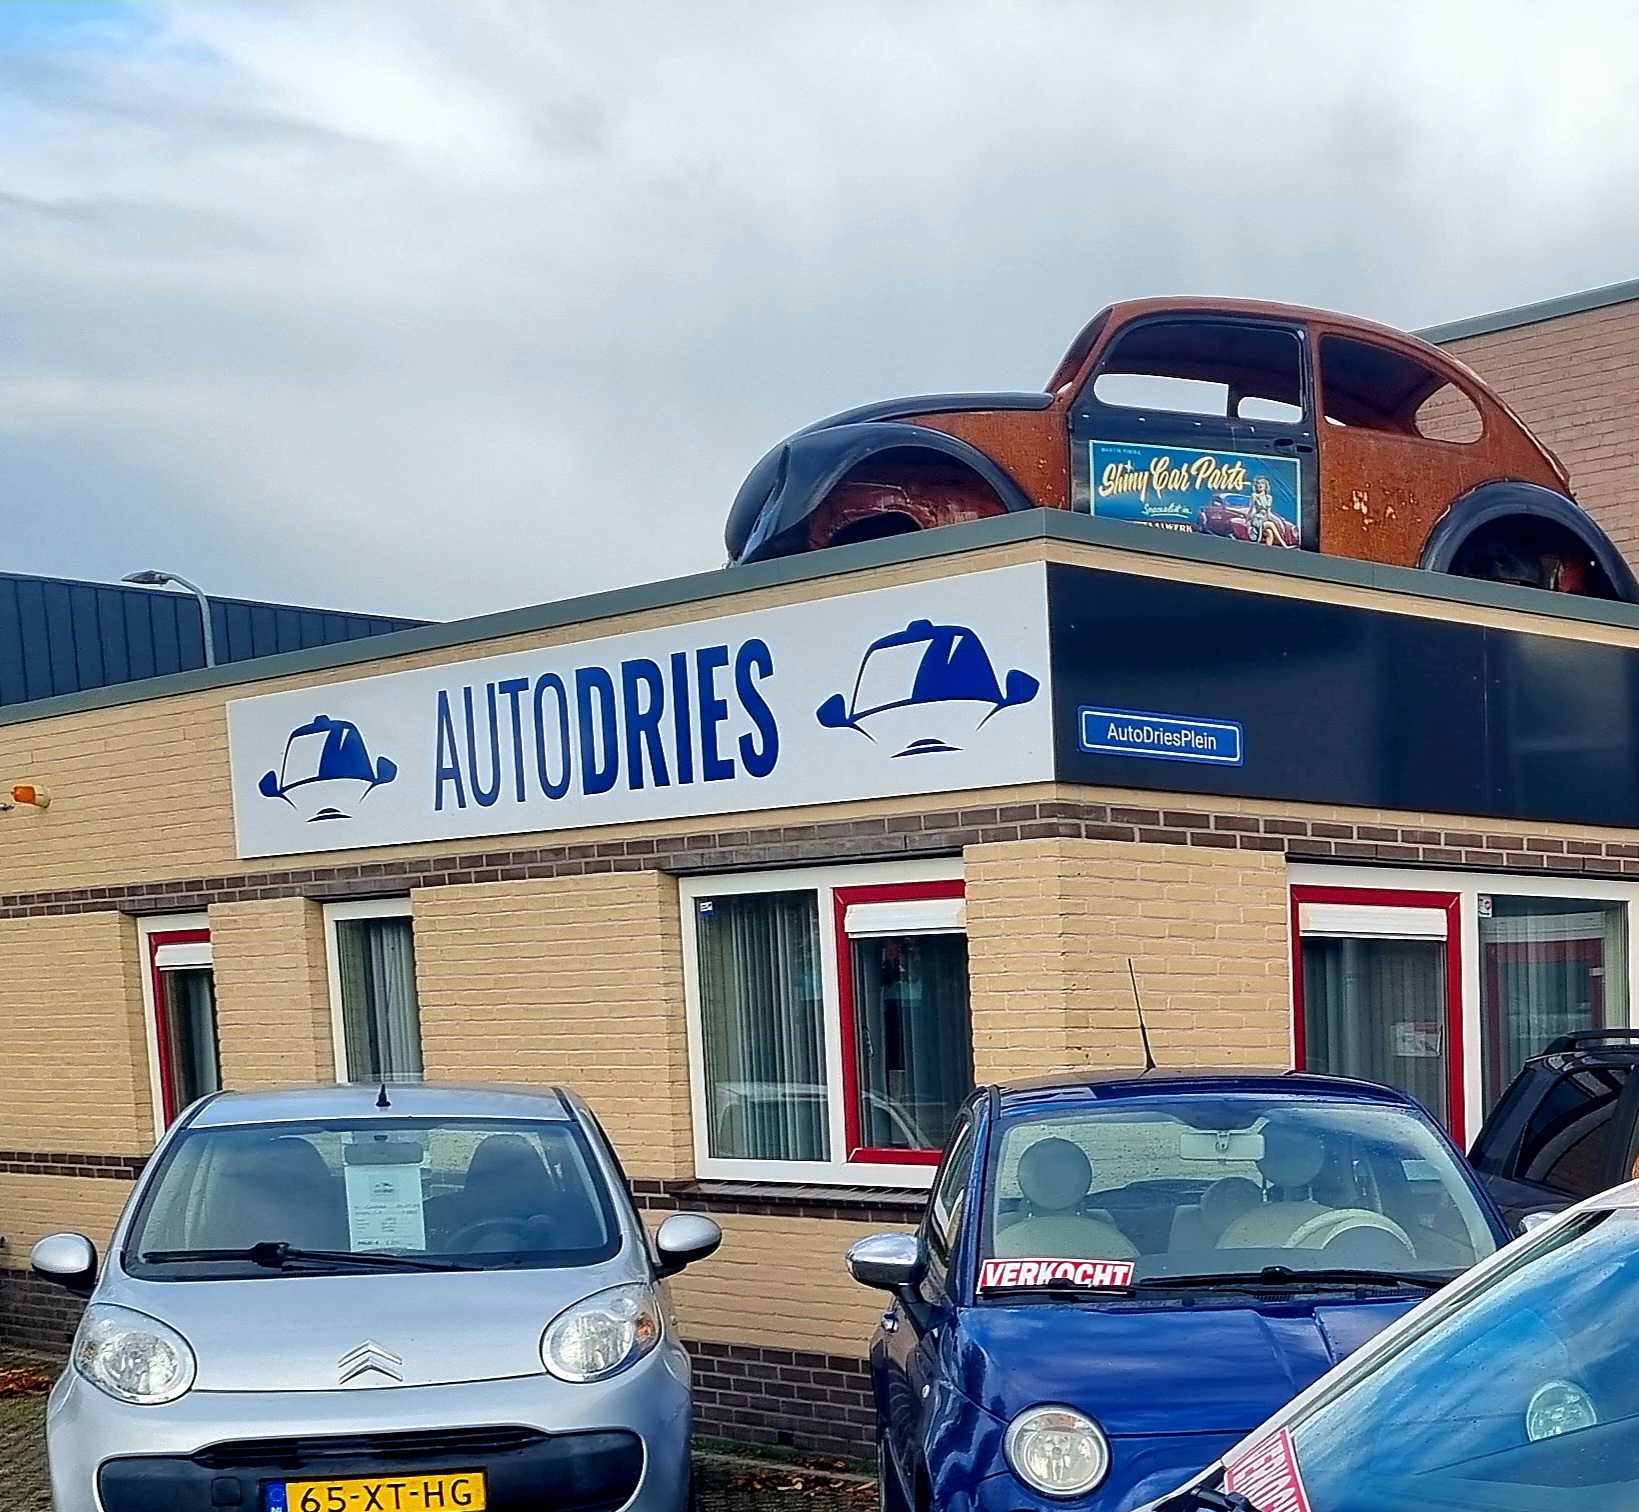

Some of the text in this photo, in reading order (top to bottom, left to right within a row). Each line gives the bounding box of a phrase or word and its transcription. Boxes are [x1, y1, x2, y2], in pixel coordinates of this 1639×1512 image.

[1098, 456, 1250, 502] Shiny Car Parts
[434, 638, 780, 811] AUTODRIES
[1107, 722, 1217, 750] AutoDriesPlein
[985, 1261, 1130, 1288] VERKOCHT
